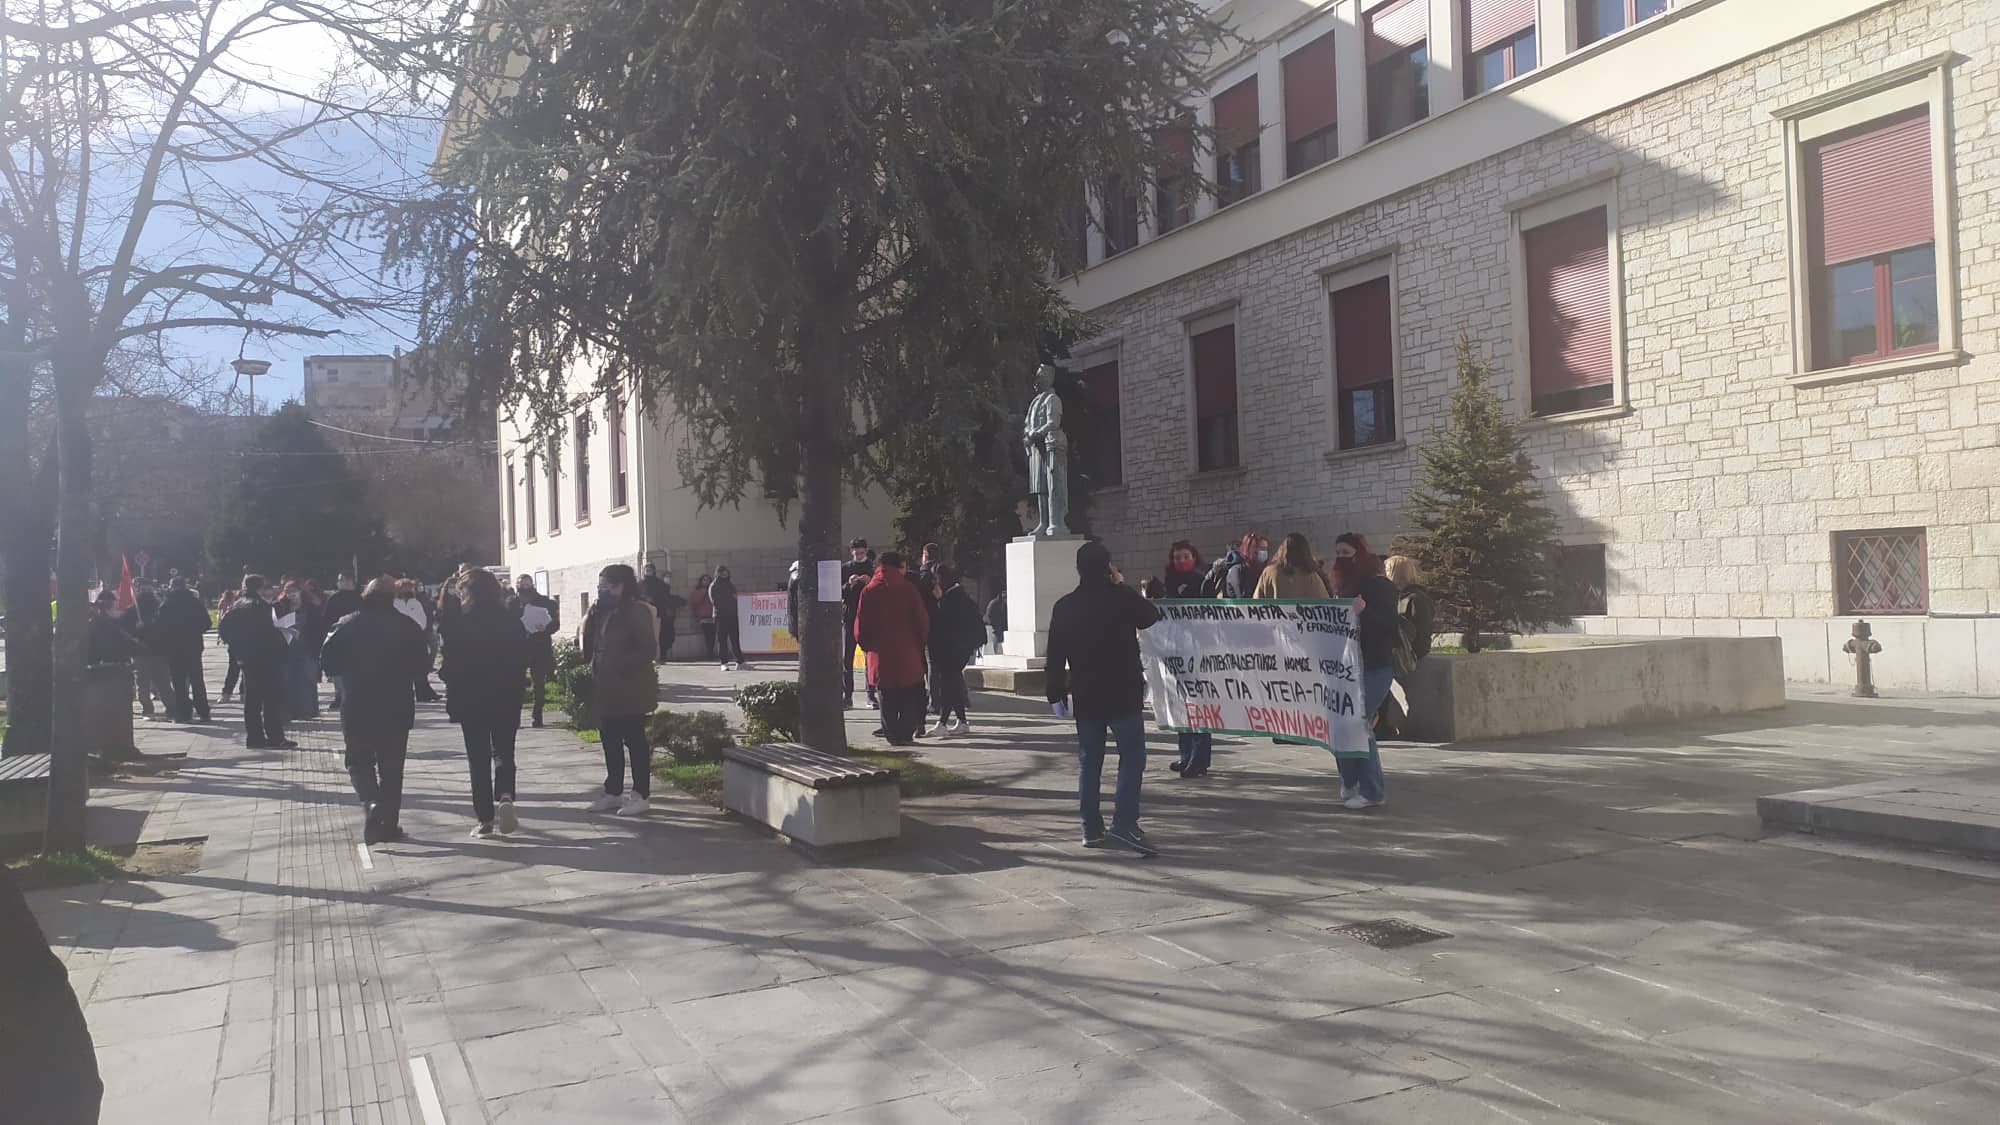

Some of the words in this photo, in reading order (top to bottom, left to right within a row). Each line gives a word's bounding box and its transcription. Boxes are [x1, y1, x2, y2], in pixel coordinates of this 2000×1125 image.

[1248, 605, 1288, 621] ΜΕΤΡΑ
[1188, 656, 1195, 673] Ο
[1284, 656, 1312, 672] ΝΟΜΟΣ
[1176, 679, 1220, 698] ΛΕΦΤΑ
[1225, 678, 1252, 700] ΓΙΑ
[1184, 701, 1224, 730] ΕΑΑΚ
[1245, 705, 1331, 744] ΙΩΑΝΝΙΝΩΝ
